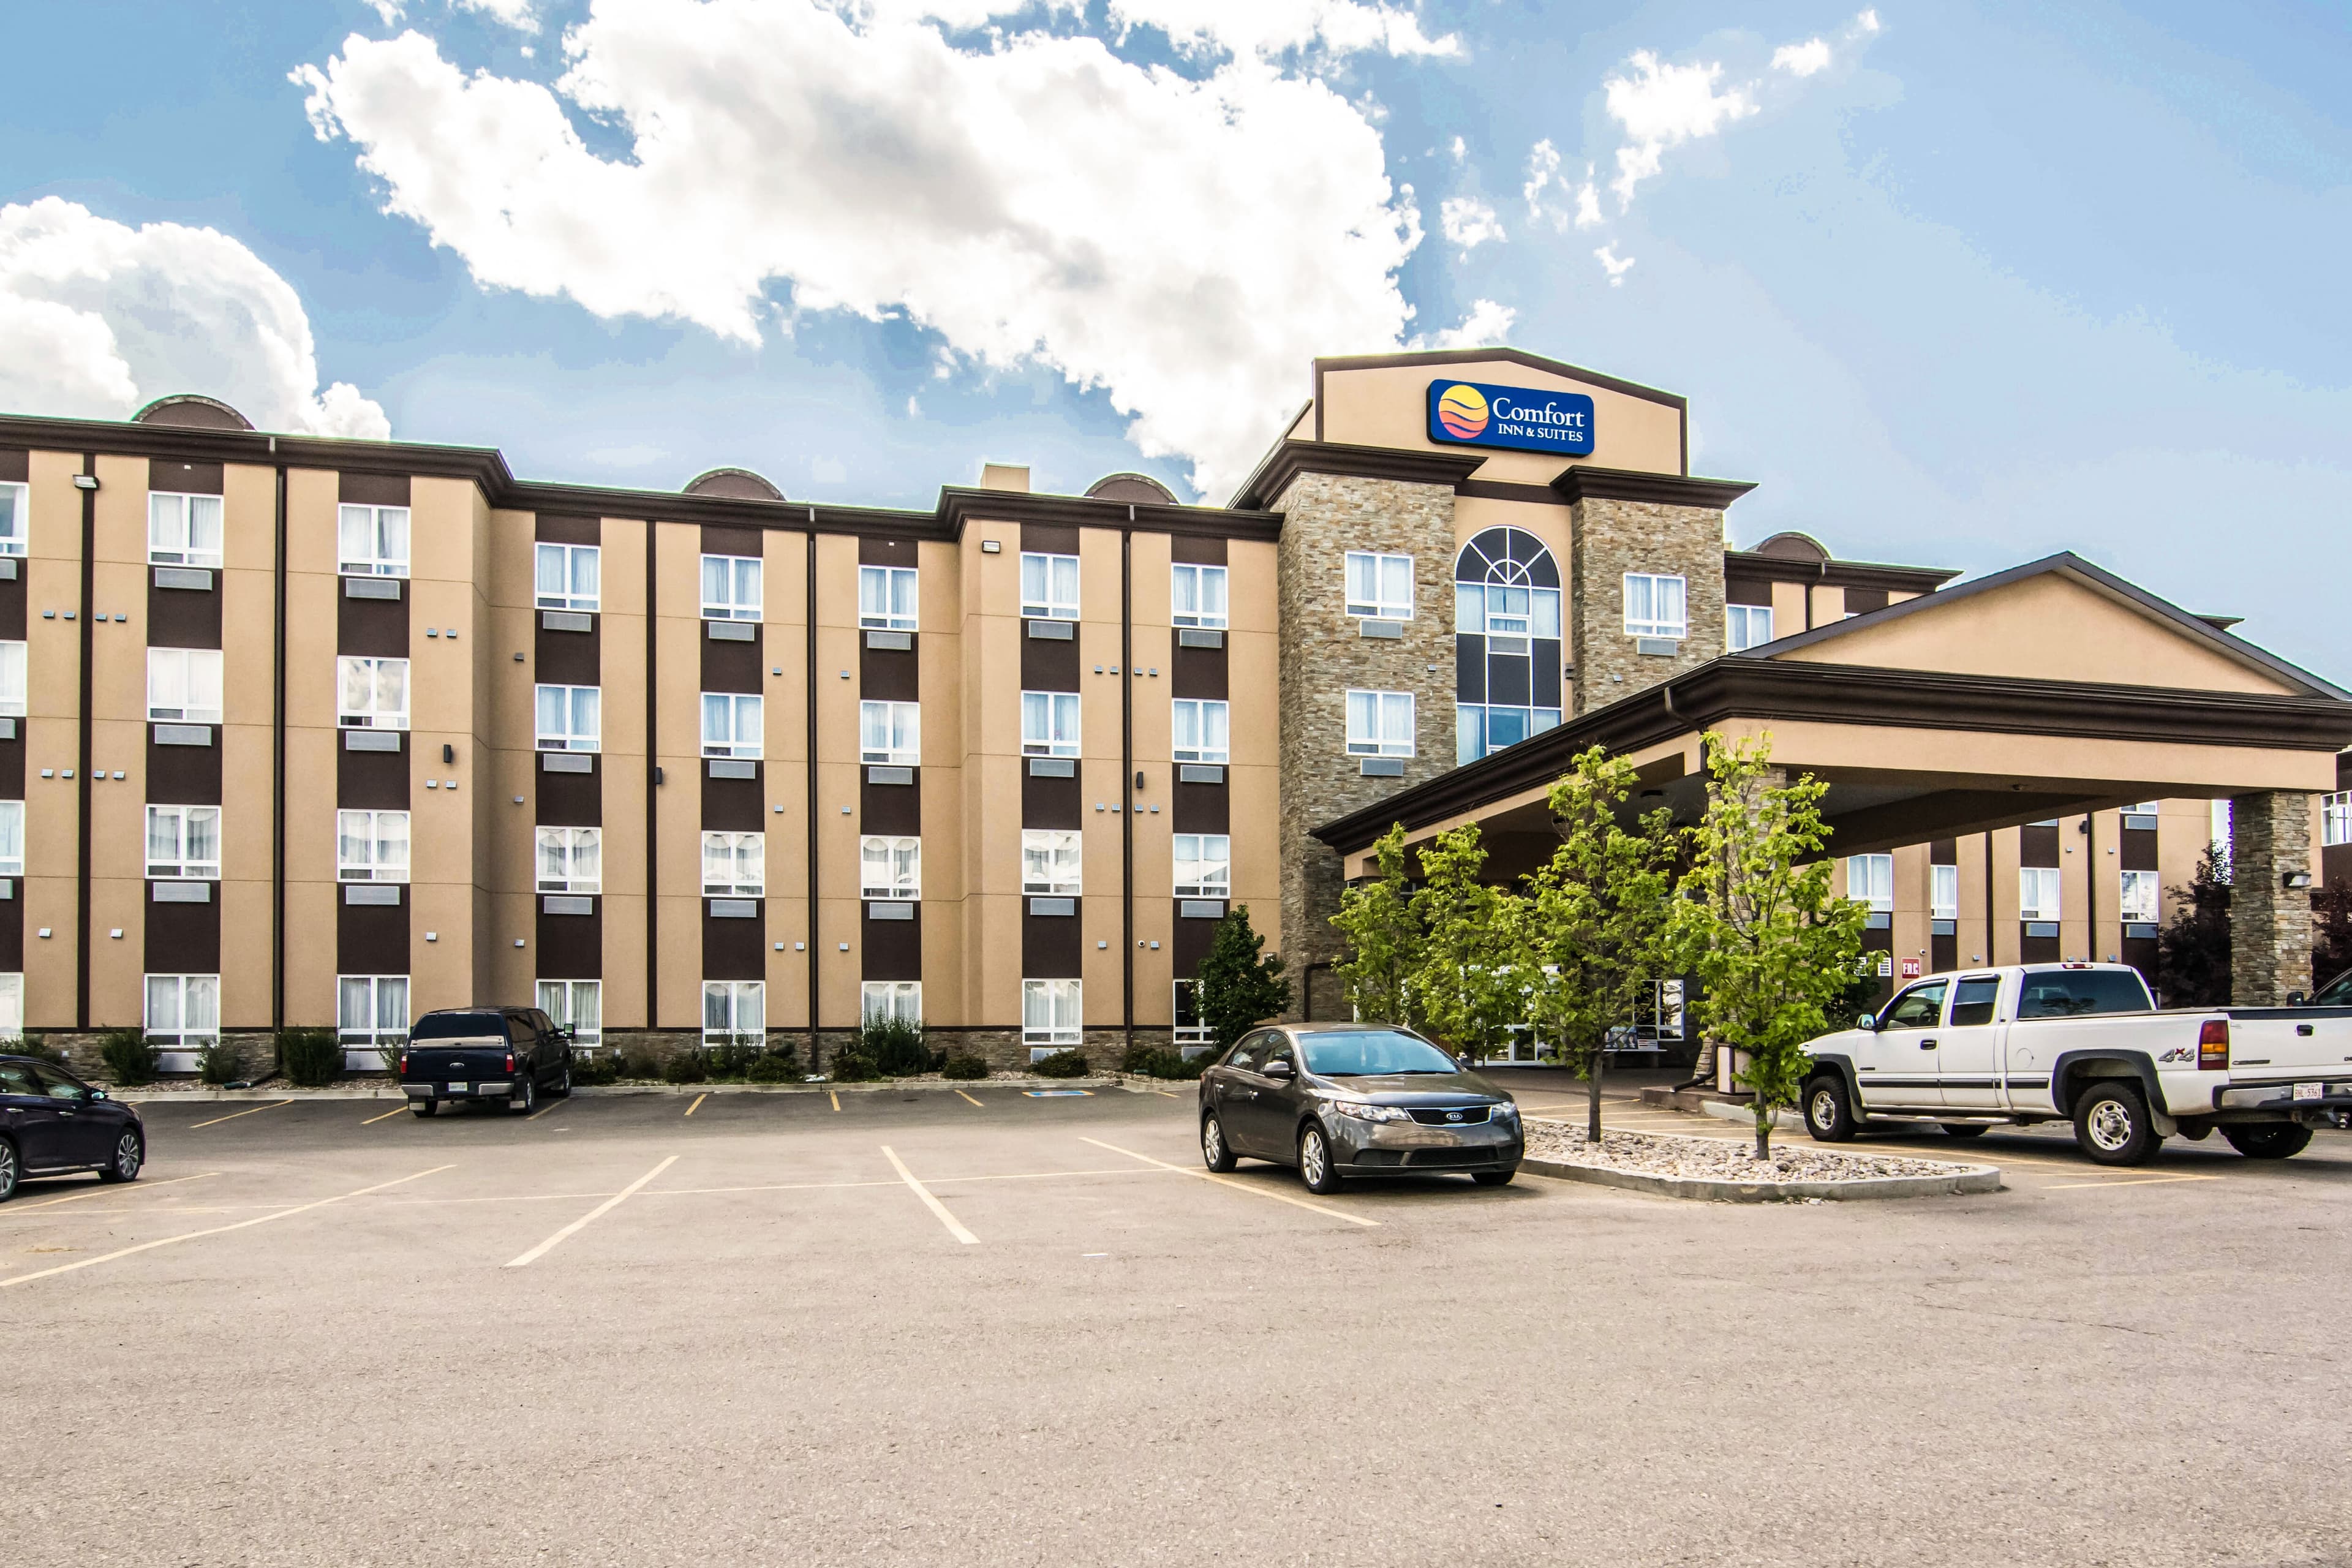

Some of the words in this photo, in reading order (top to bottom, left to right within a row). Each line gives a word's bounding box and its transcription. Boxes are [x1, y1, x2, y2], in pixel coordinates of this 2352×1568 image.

[1493, 398, 1585, 427] Comfort
[1498, 423, 1523, 435] INN
[1526, 428, 1535, 437] &
[1537, 428, 1583, 442] SUITES
